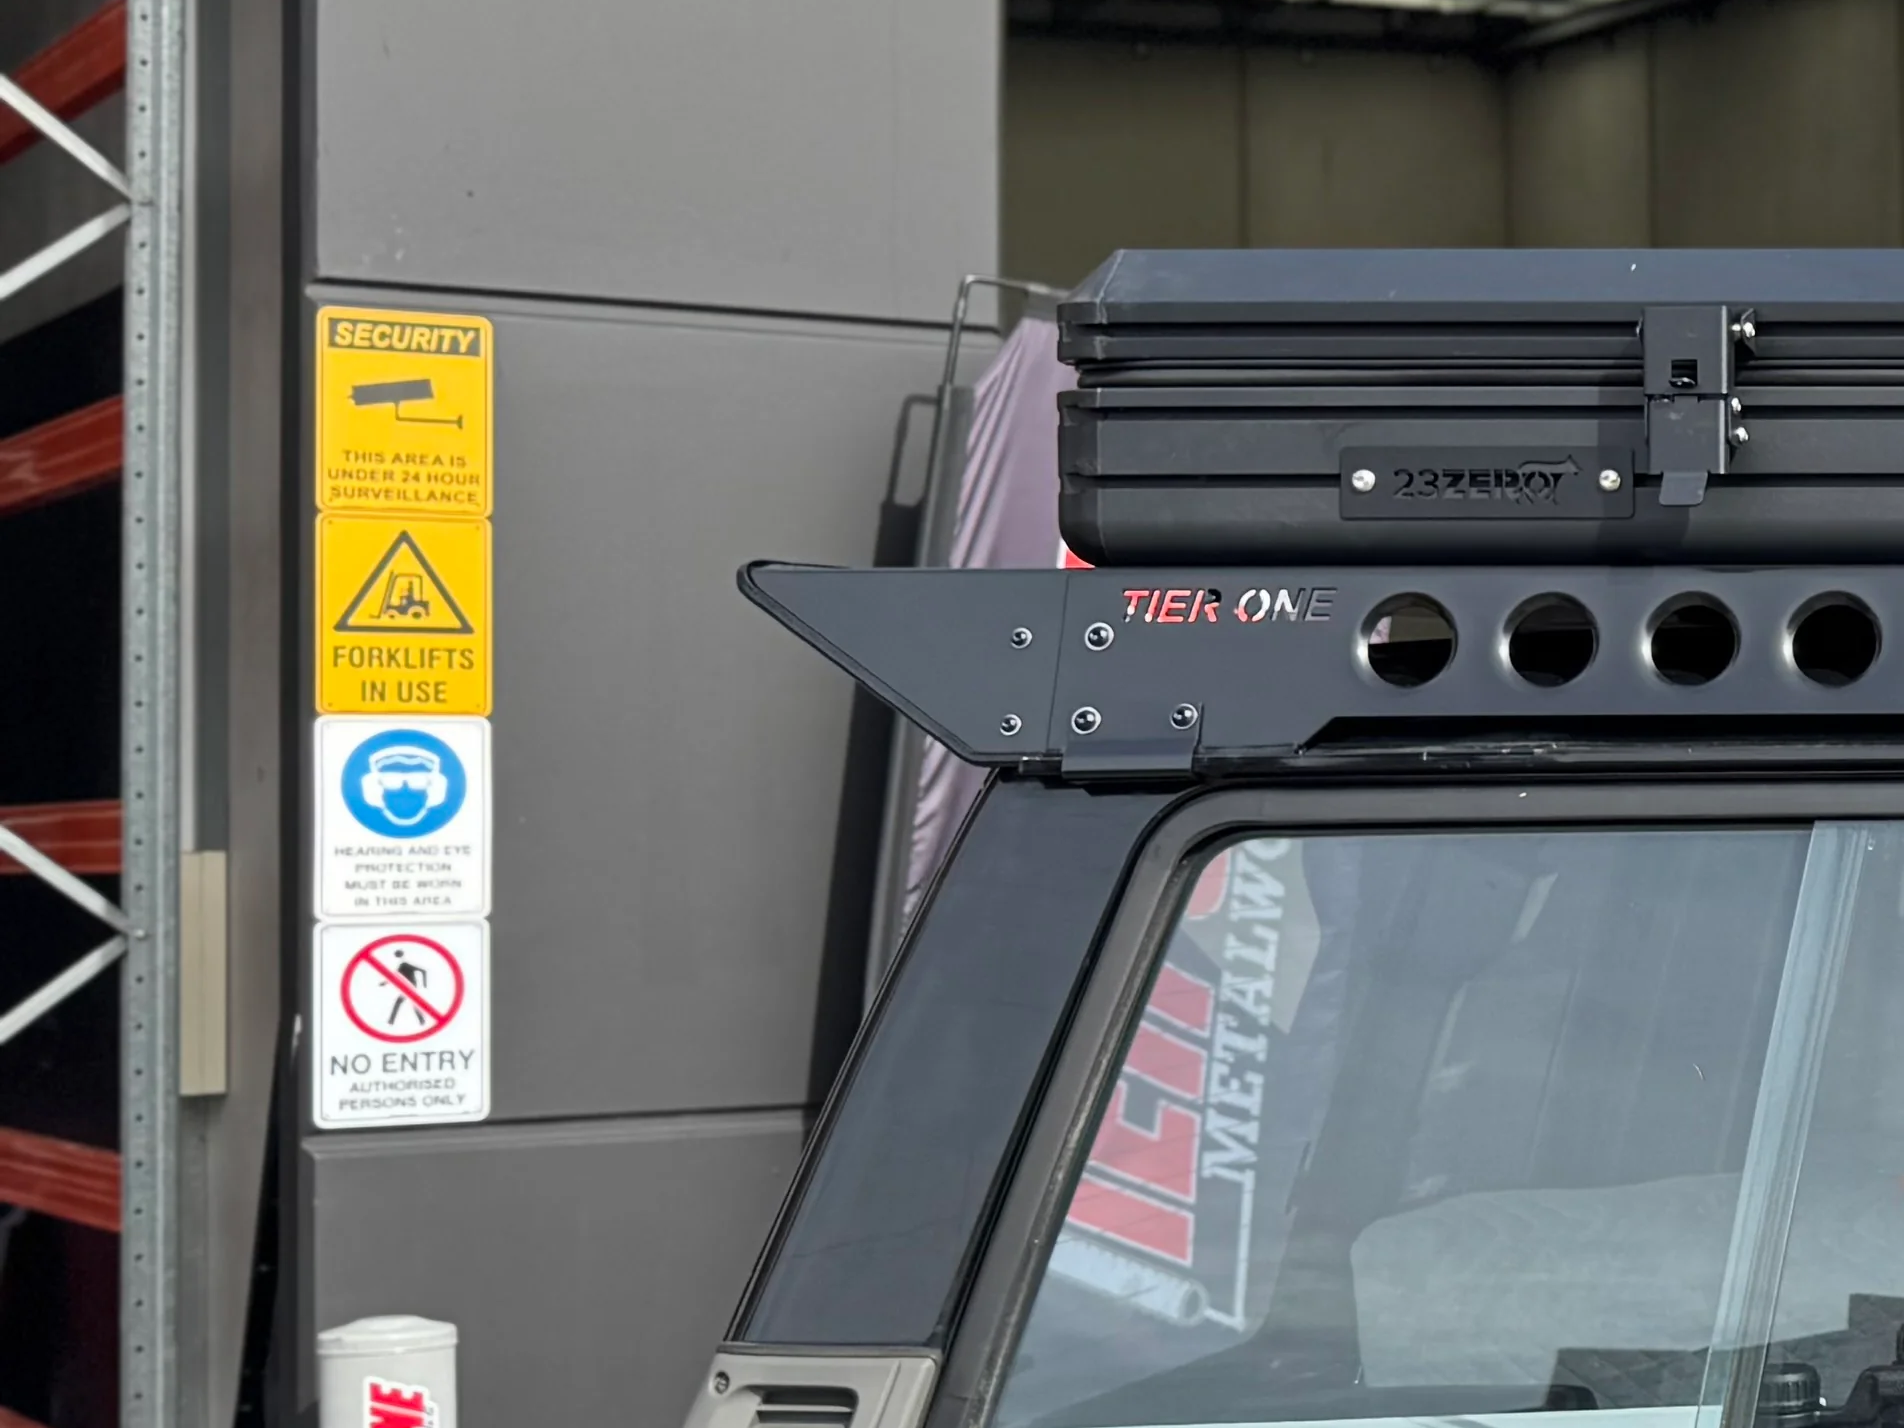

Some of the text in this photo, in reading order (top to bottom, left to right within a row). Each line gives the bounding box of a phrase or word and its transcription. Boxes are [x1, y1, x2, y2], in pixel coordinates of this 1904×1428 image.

[334, 322, 477, 353] SECURITY
[343, 449, 467, 469] THIS AREA IS
[327, 468, 480, 486] UNDER 24 HOUR
[1391, 468, 1556, 501] 23ZERO
[330, 485, 478, 504] SURVEILLANCE
[1122, 587, 1338, 623] TIER ONE
[332, 645, 475, 670] FORKLIFTS
[361, 680, 448, 704] IN USE
[334, 845, 472, 857] HEARING AND EYE
[355, 862, 452, 874] PROTECTION
[345, 879, 462, 890] MUST BE WORN
[375, 896, 407, 906] THIS
[413, 896, 451, 905] AREA
[330, 1049, 475, 1076] NO ENTRY
[349, 1077, 456, 1093] AUTHORISED
[339, 1093, 466, 1111] PERSONS ONLY
